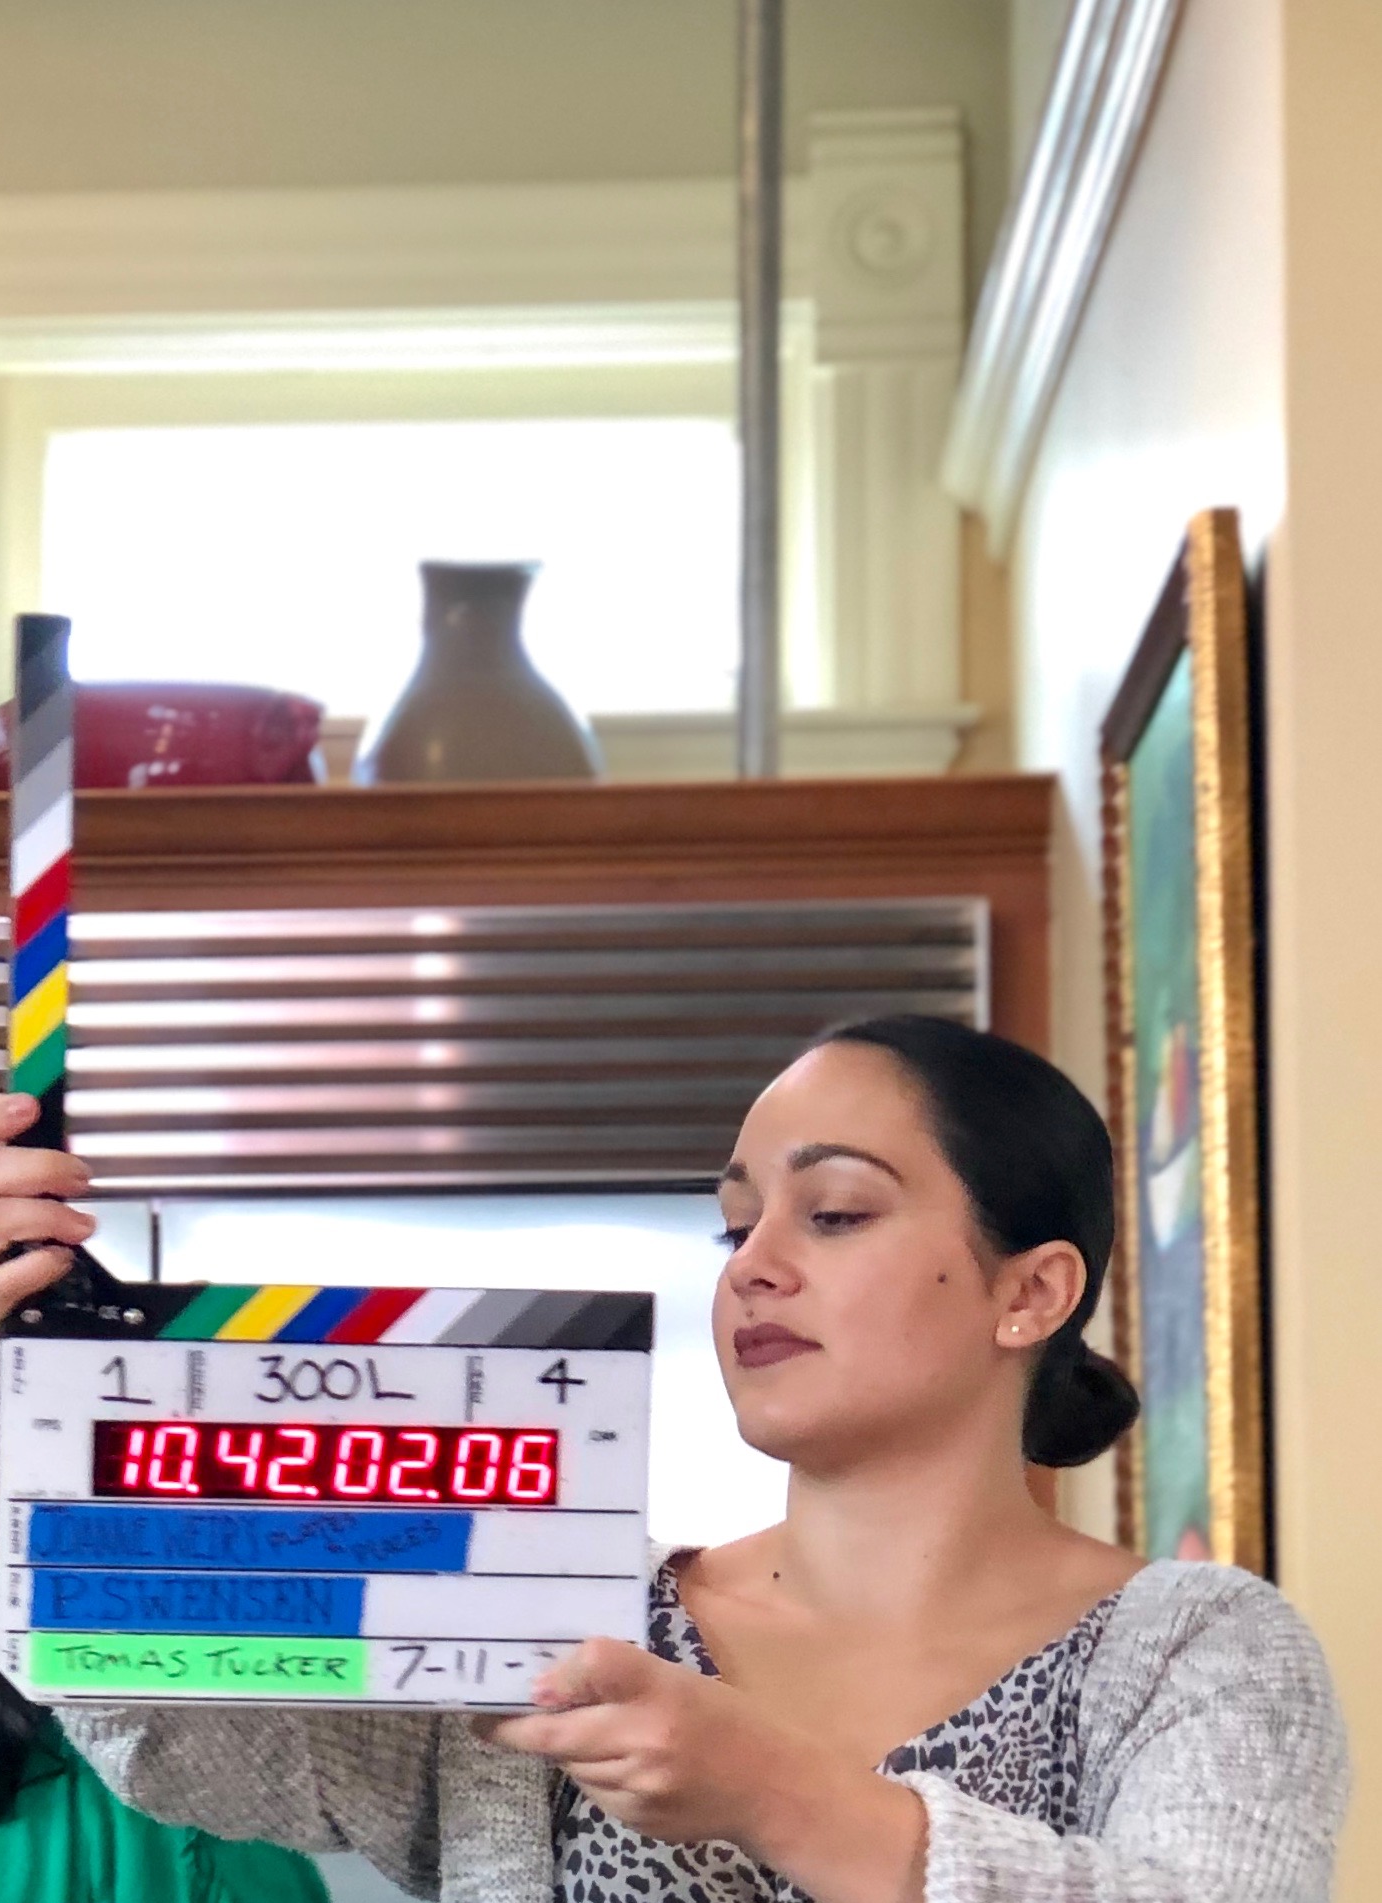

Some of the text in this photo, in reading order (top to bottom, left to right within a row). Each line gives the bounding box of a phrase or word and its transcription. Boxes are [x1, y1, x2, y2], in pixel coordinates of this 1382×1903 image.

[100, 1355, 154, 1405] 1
[255, 1356, 416, 1405] 300L
[538, 1358, 587, 1405] 4
[55, 1644, 189, 1679] TOMAS
[204, 1646, 349, 1681] TUCKER
[390, 1644, 556, 1691] 7-11-
